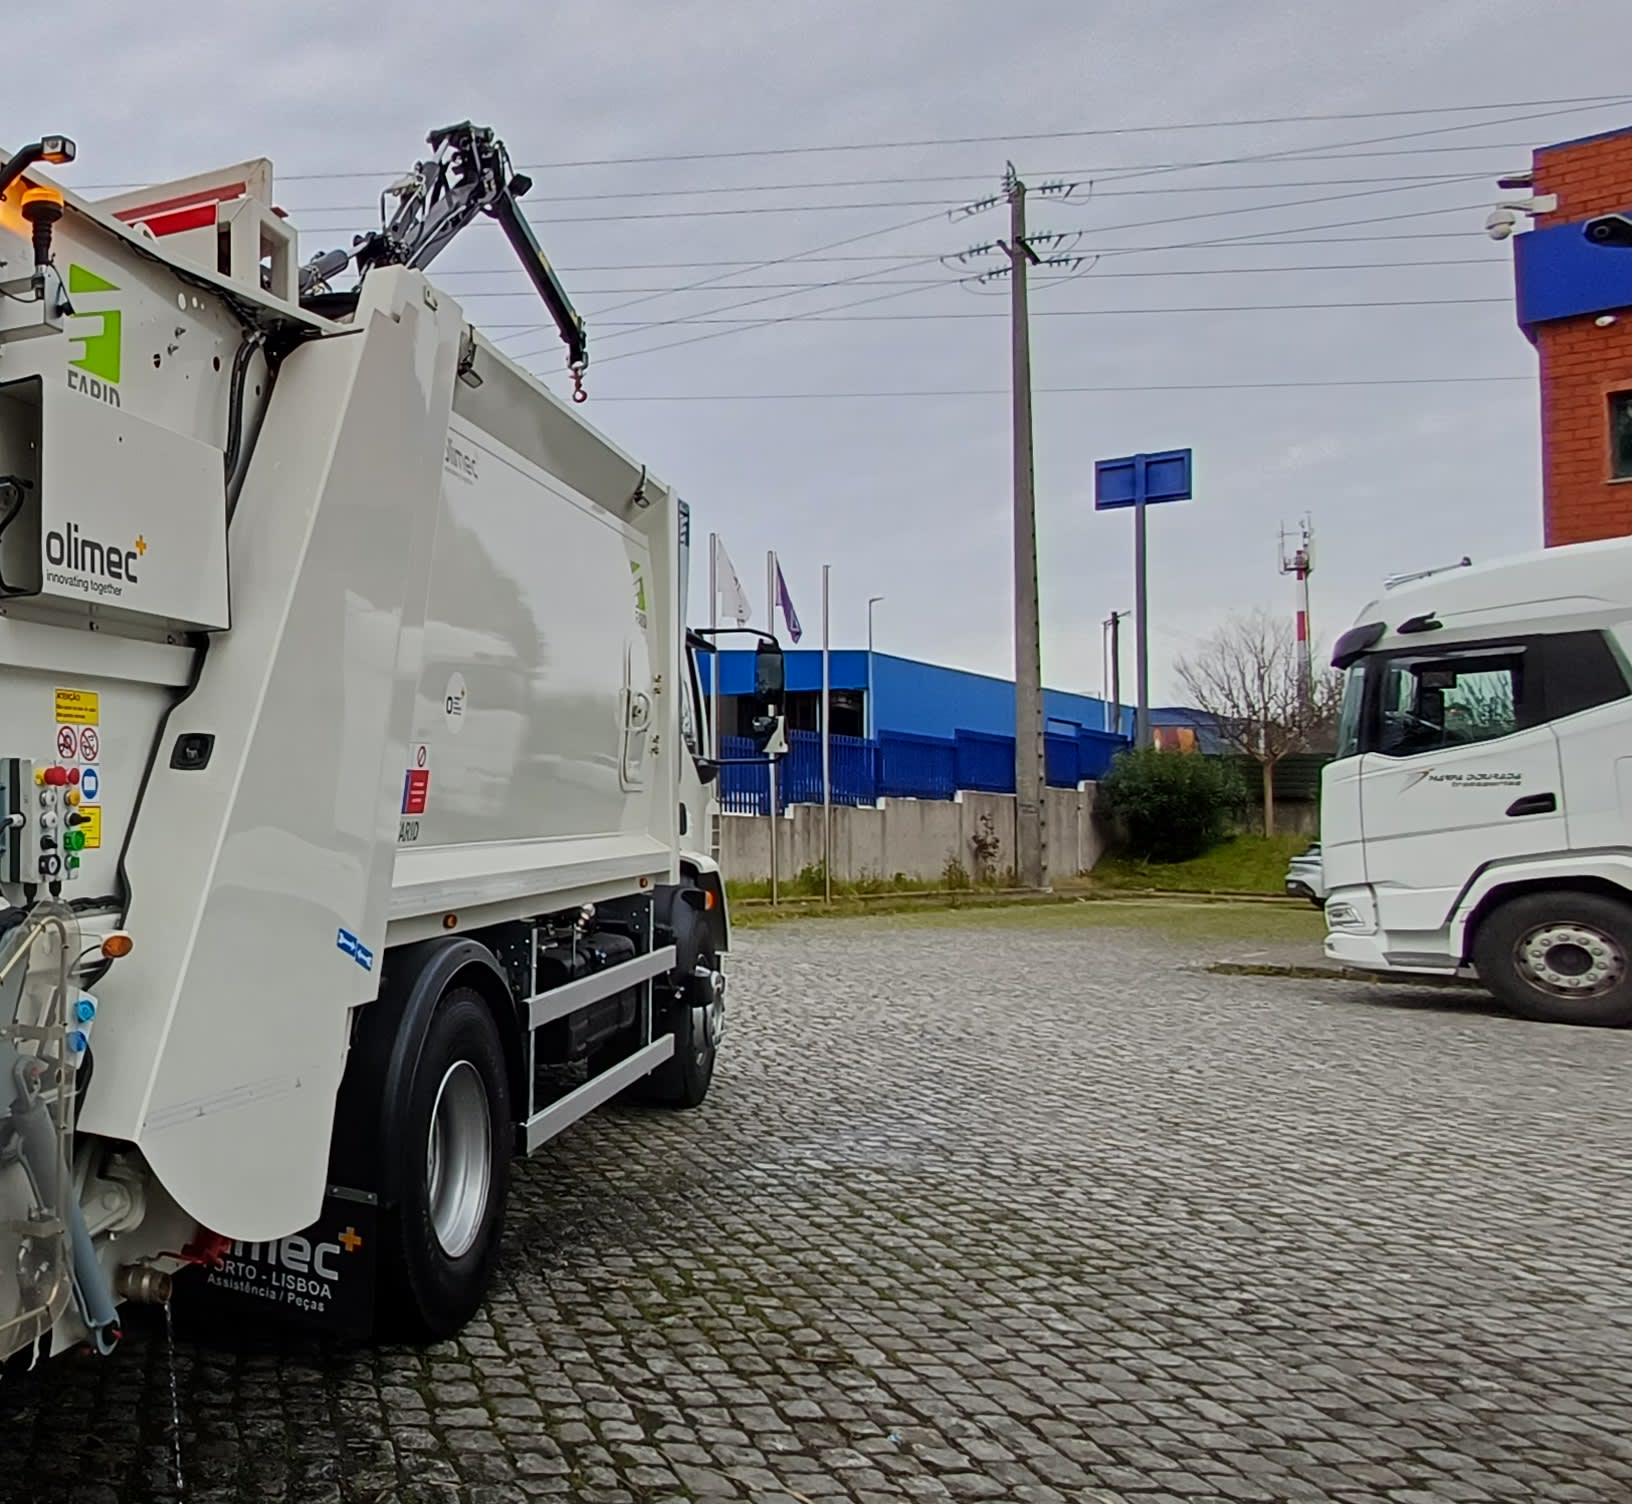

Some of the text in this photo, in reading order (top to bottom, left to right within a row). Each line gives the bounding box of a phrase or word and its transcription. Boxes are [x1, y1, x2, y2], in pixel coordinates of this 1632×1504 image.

[46, 521, 138, 584] olimec
[47, 569, 122, 596] innovating together
[397, 821, 419, 842] ARID
[203, 1257, 257, 1280] ORTO
[271, 1271, 333, 1300] LISBOA
[207, 1272, 277, 1301] Assistência
[287, 1292, 325, 1313] Peças
